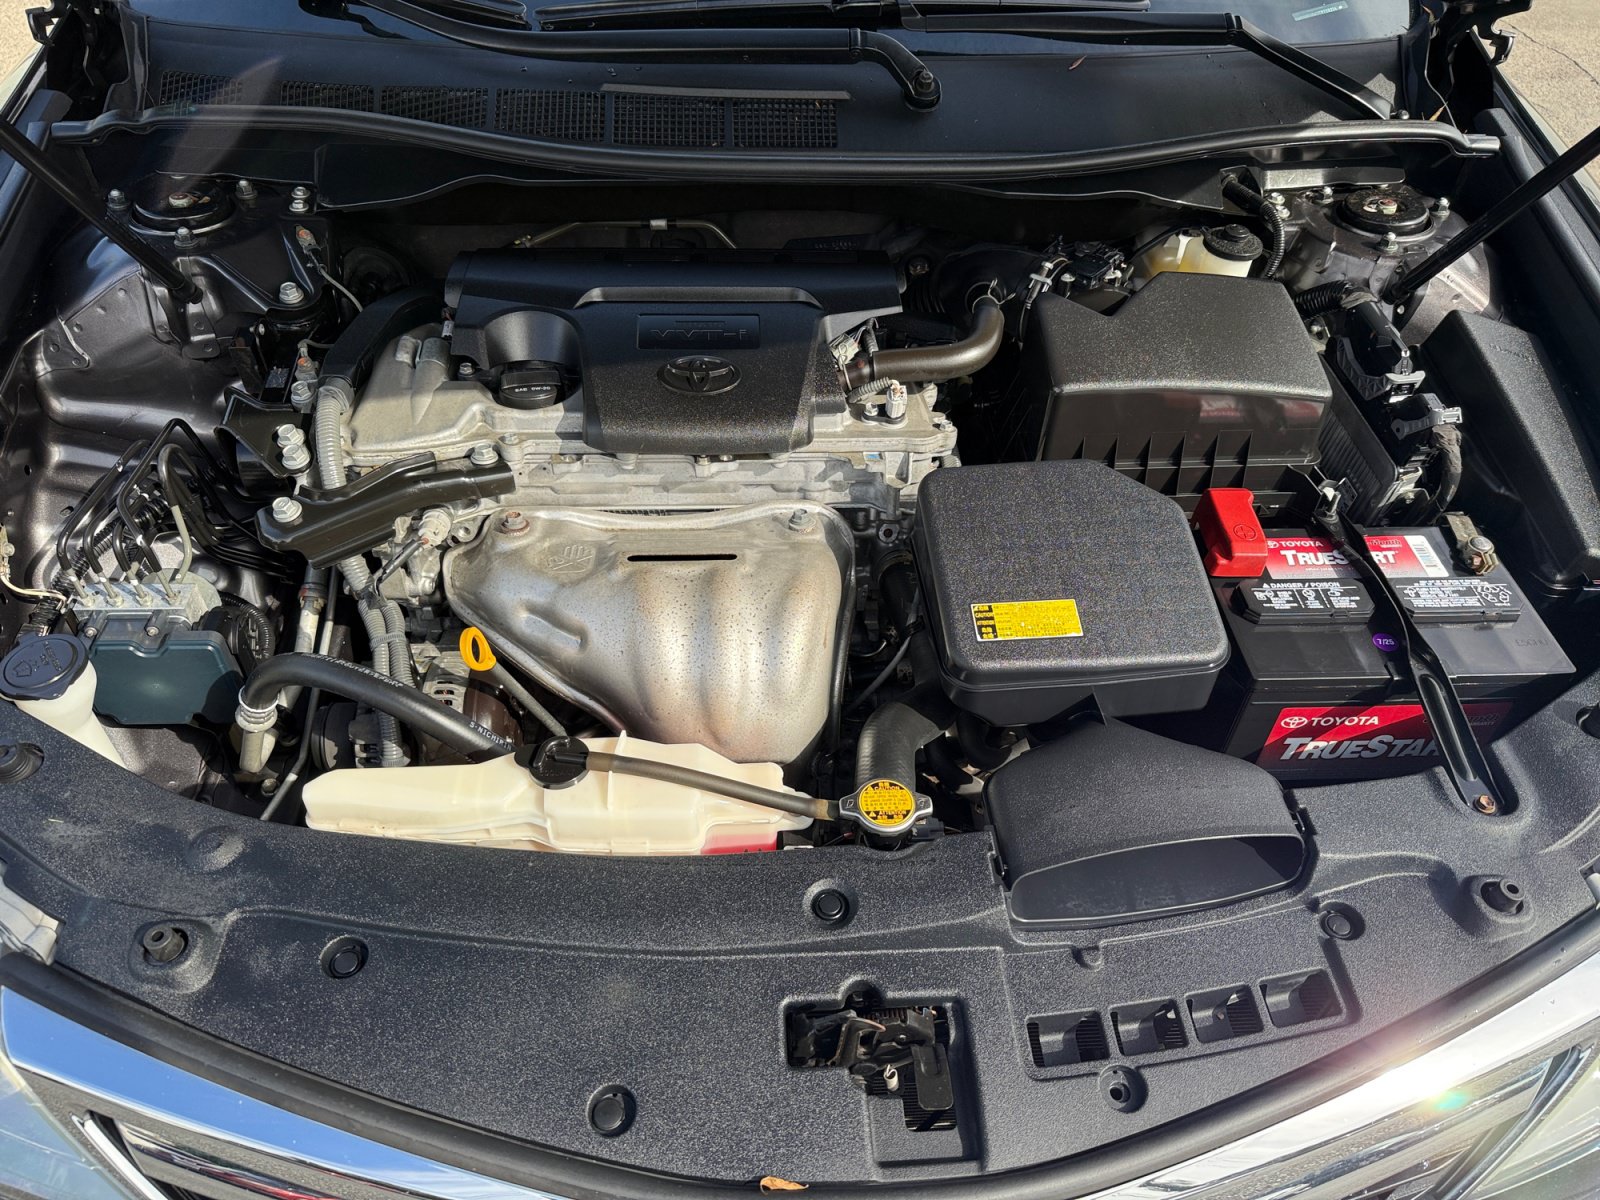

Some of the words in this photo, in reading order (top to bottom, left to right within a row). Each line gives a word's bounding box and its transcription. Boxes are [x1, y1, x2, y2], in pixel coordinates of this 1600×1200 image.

[650, 328, 748, 341] VVT-i
[1279, 540, 1324, 548] TOYOTA
[1280, 549, 1397, 566] TRUESRT
[1376, 638, 1396, 646] 7/25
[1311, 716, 1379, 726] TOYOTA
[1280, 735, 1439, 760] TRUESTAR
